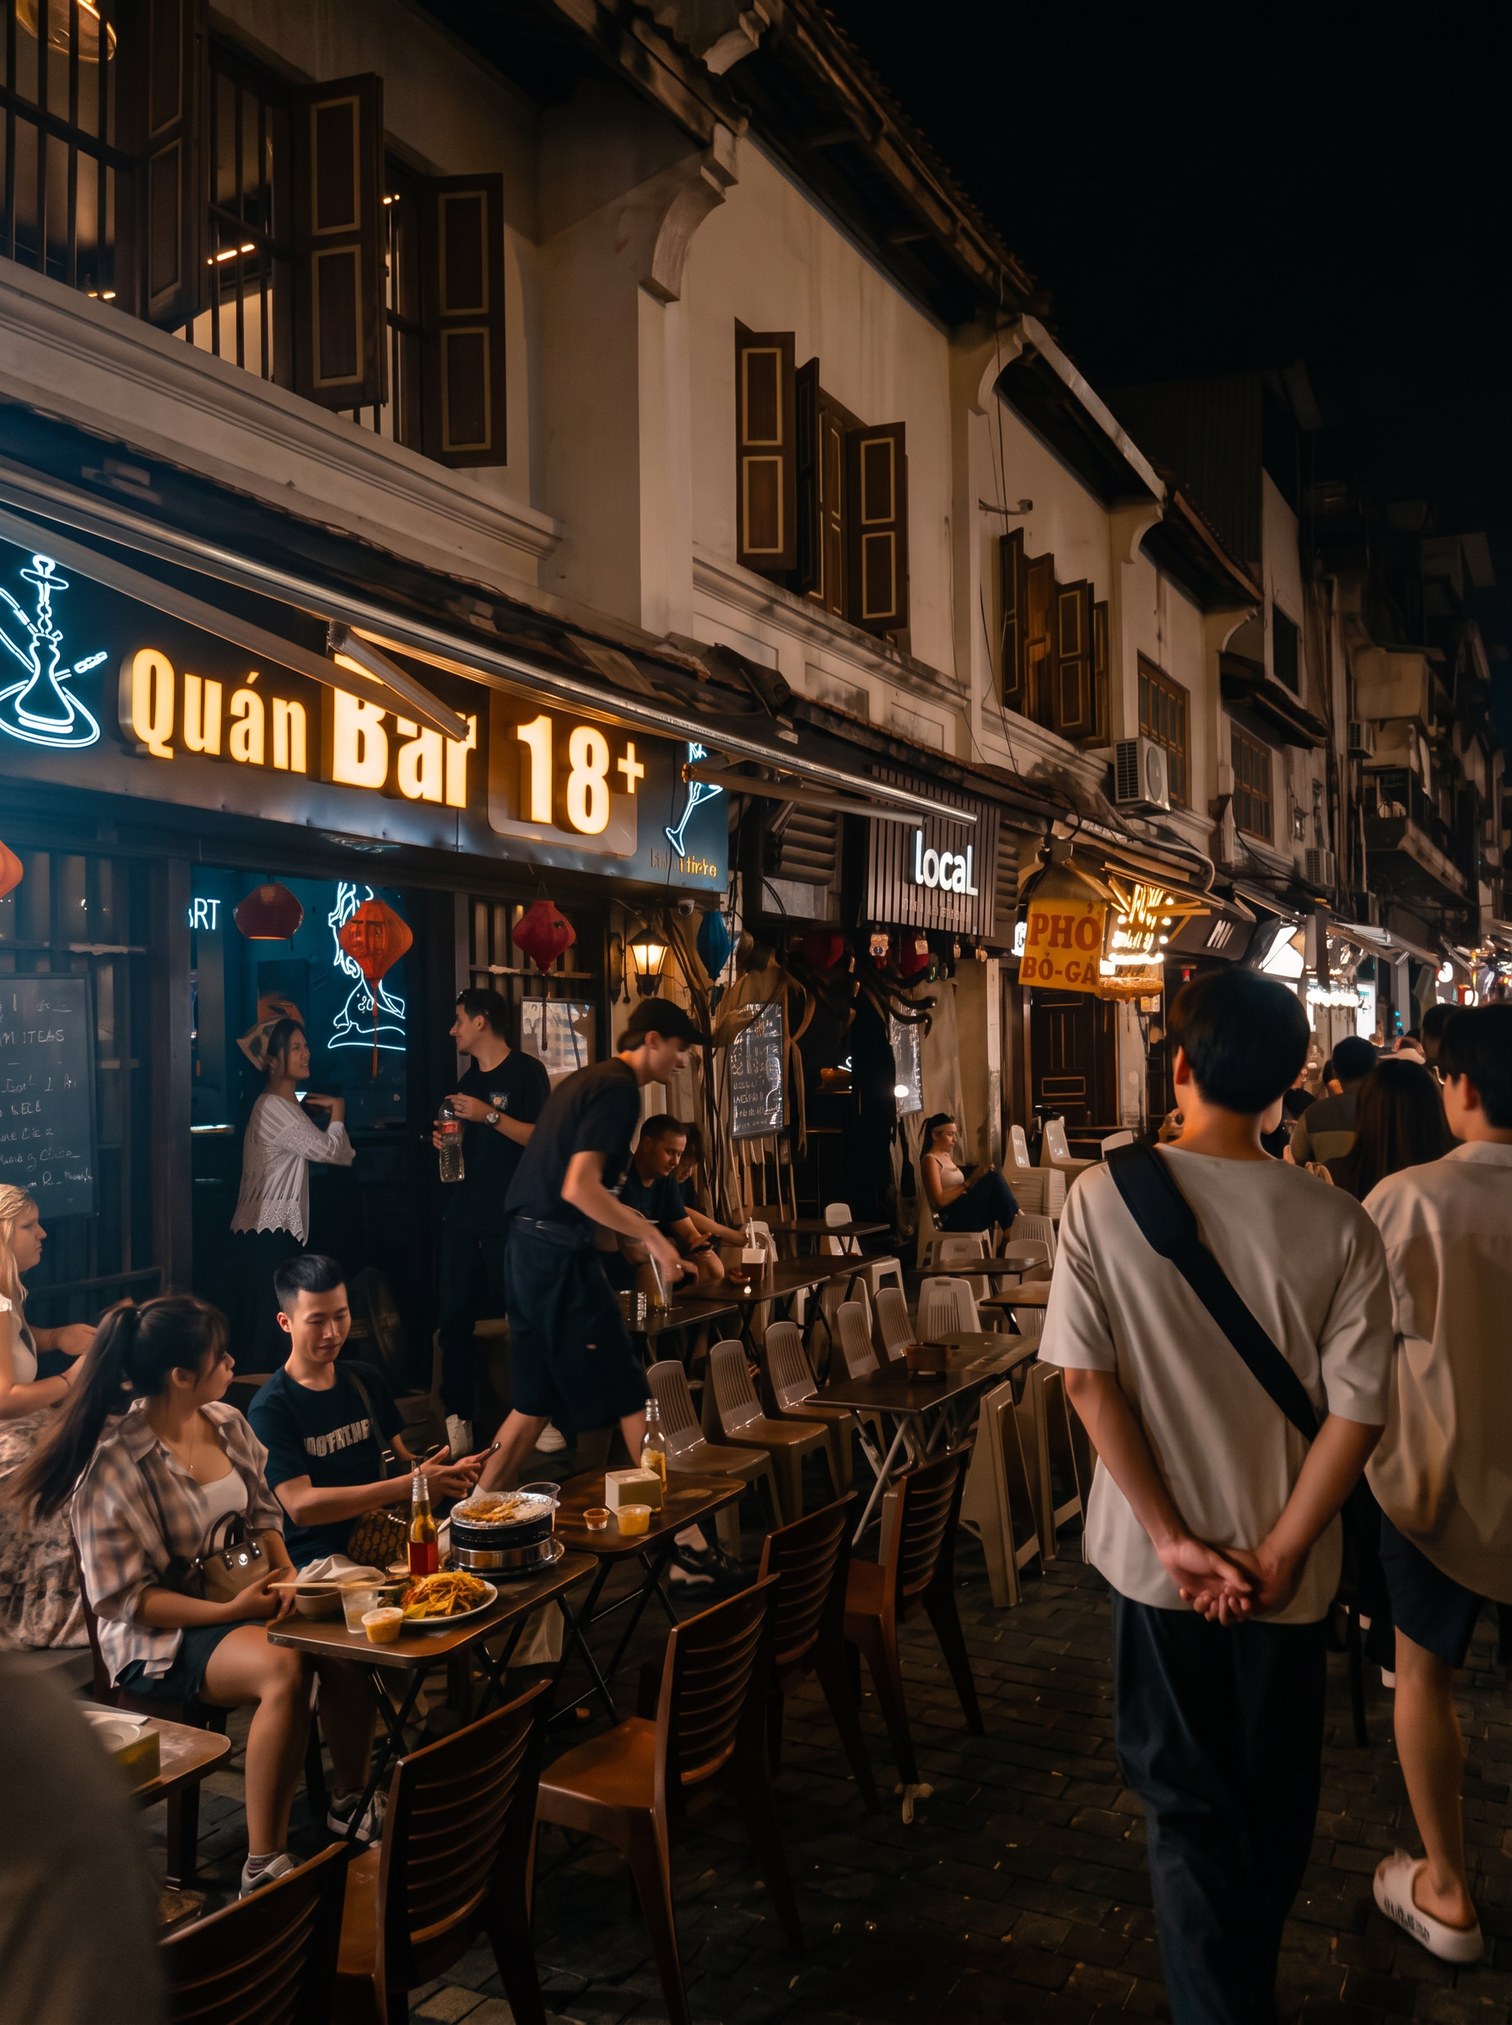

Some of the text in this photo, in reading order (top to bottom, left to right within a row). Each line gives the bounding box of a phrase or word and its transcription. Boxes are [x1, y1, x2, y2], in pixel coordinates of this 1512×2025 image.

[131, 647, 646, 836] Quán Bar 18+
[914, 829, 979, 897] local
[188, 897, 222, 931] RT
